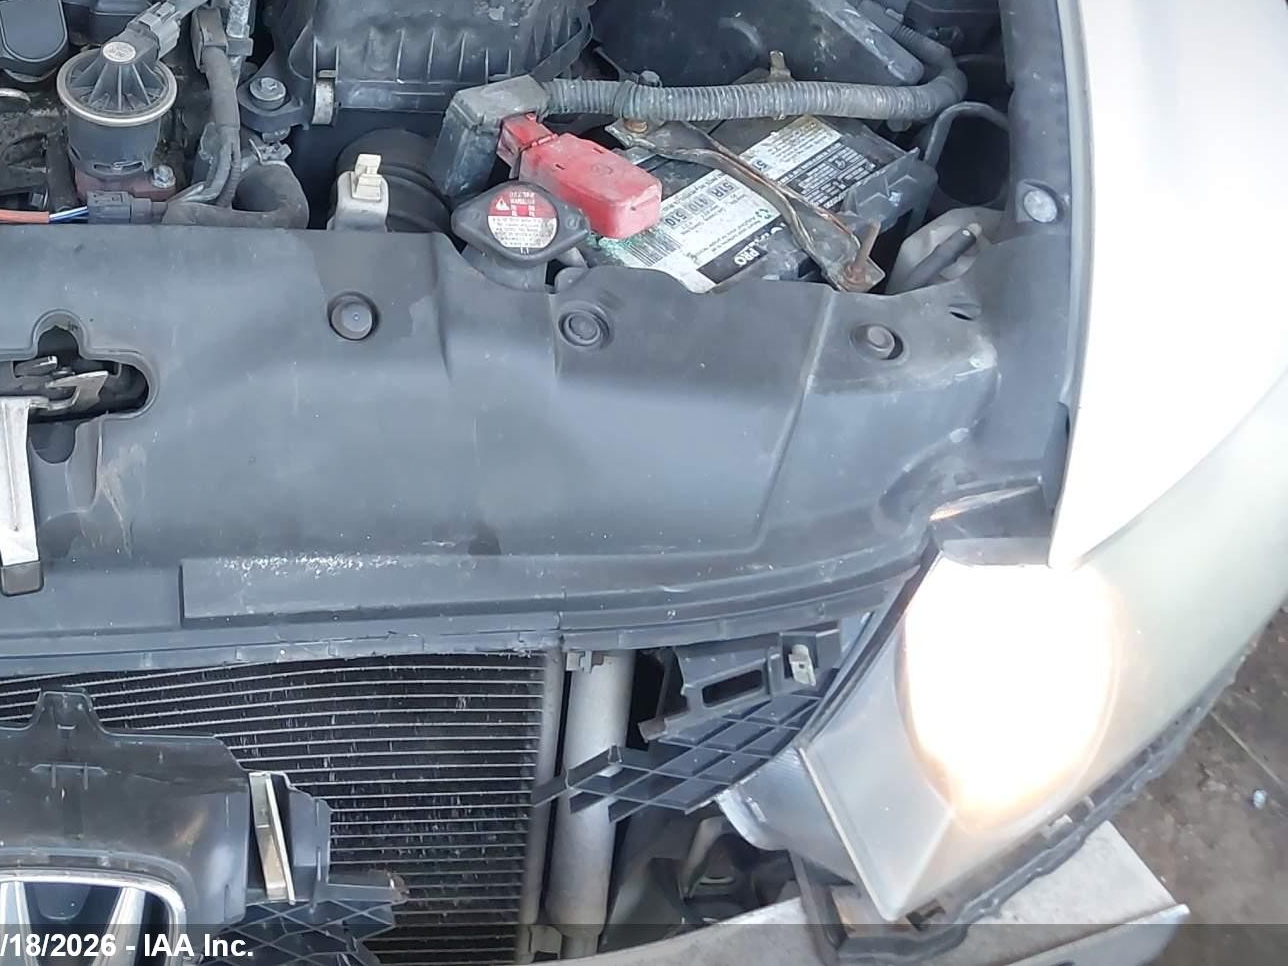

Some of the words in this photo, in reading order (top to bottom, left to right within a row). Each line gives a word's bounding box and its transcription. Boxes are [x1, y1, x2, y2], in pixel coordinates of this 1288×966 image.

[709, 180, 735, 198] 51R
[663, 209, 686, 226] 510
[732, 246, 760, 267] PRO
